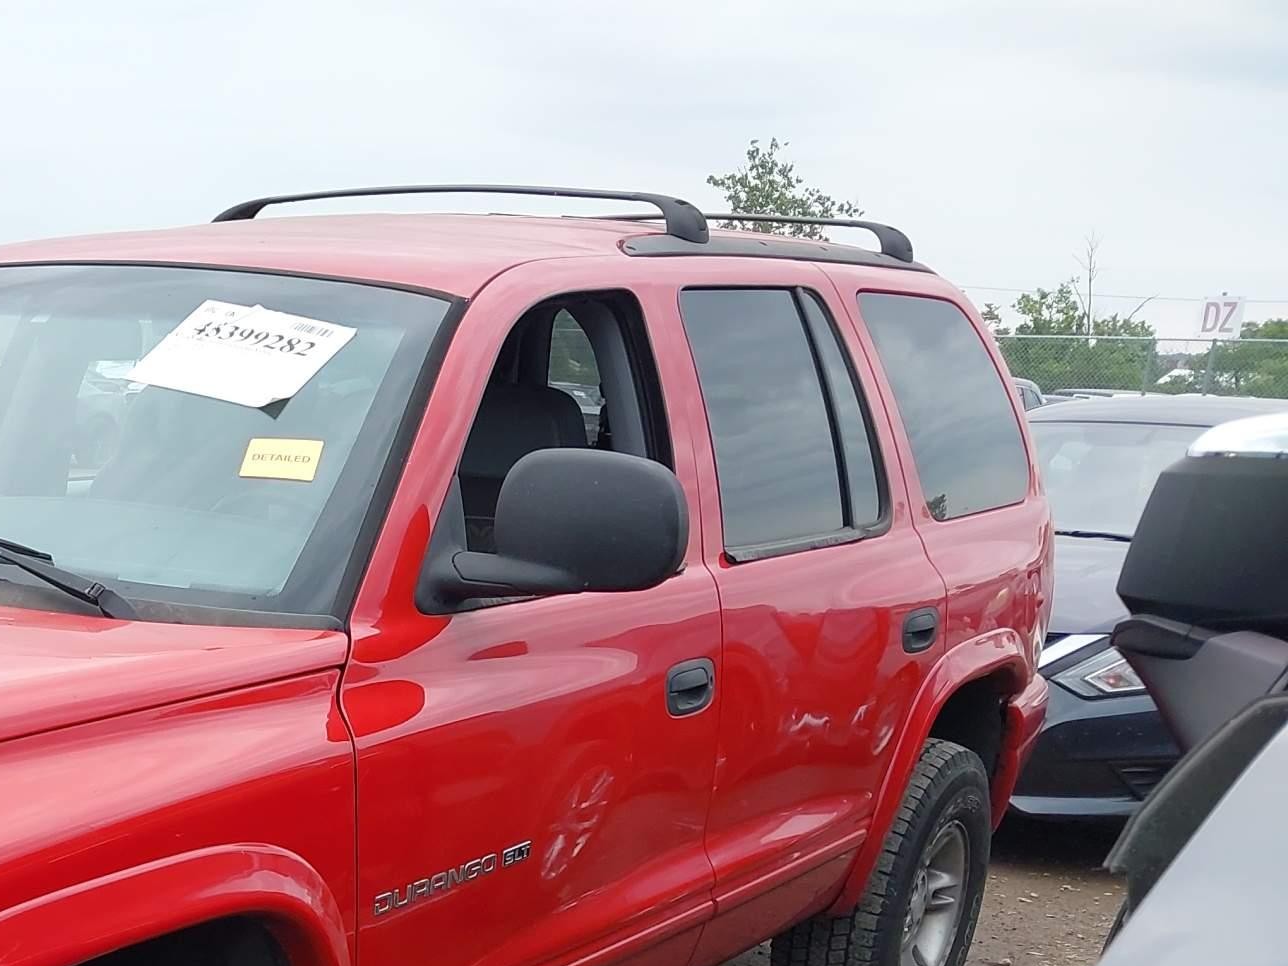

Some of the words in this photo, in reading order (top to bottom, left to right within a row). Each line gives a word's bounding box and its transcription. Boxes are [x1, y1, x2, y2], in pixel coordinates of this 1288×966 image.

[1201, 301, 1239, 333] DZ
[194, 321, 316, 356] 45399282
[252, 453, 311, 463] DETAILED
[374, 853, 498, 916] DURANGO
[503, 841, 531, 867] SLT
